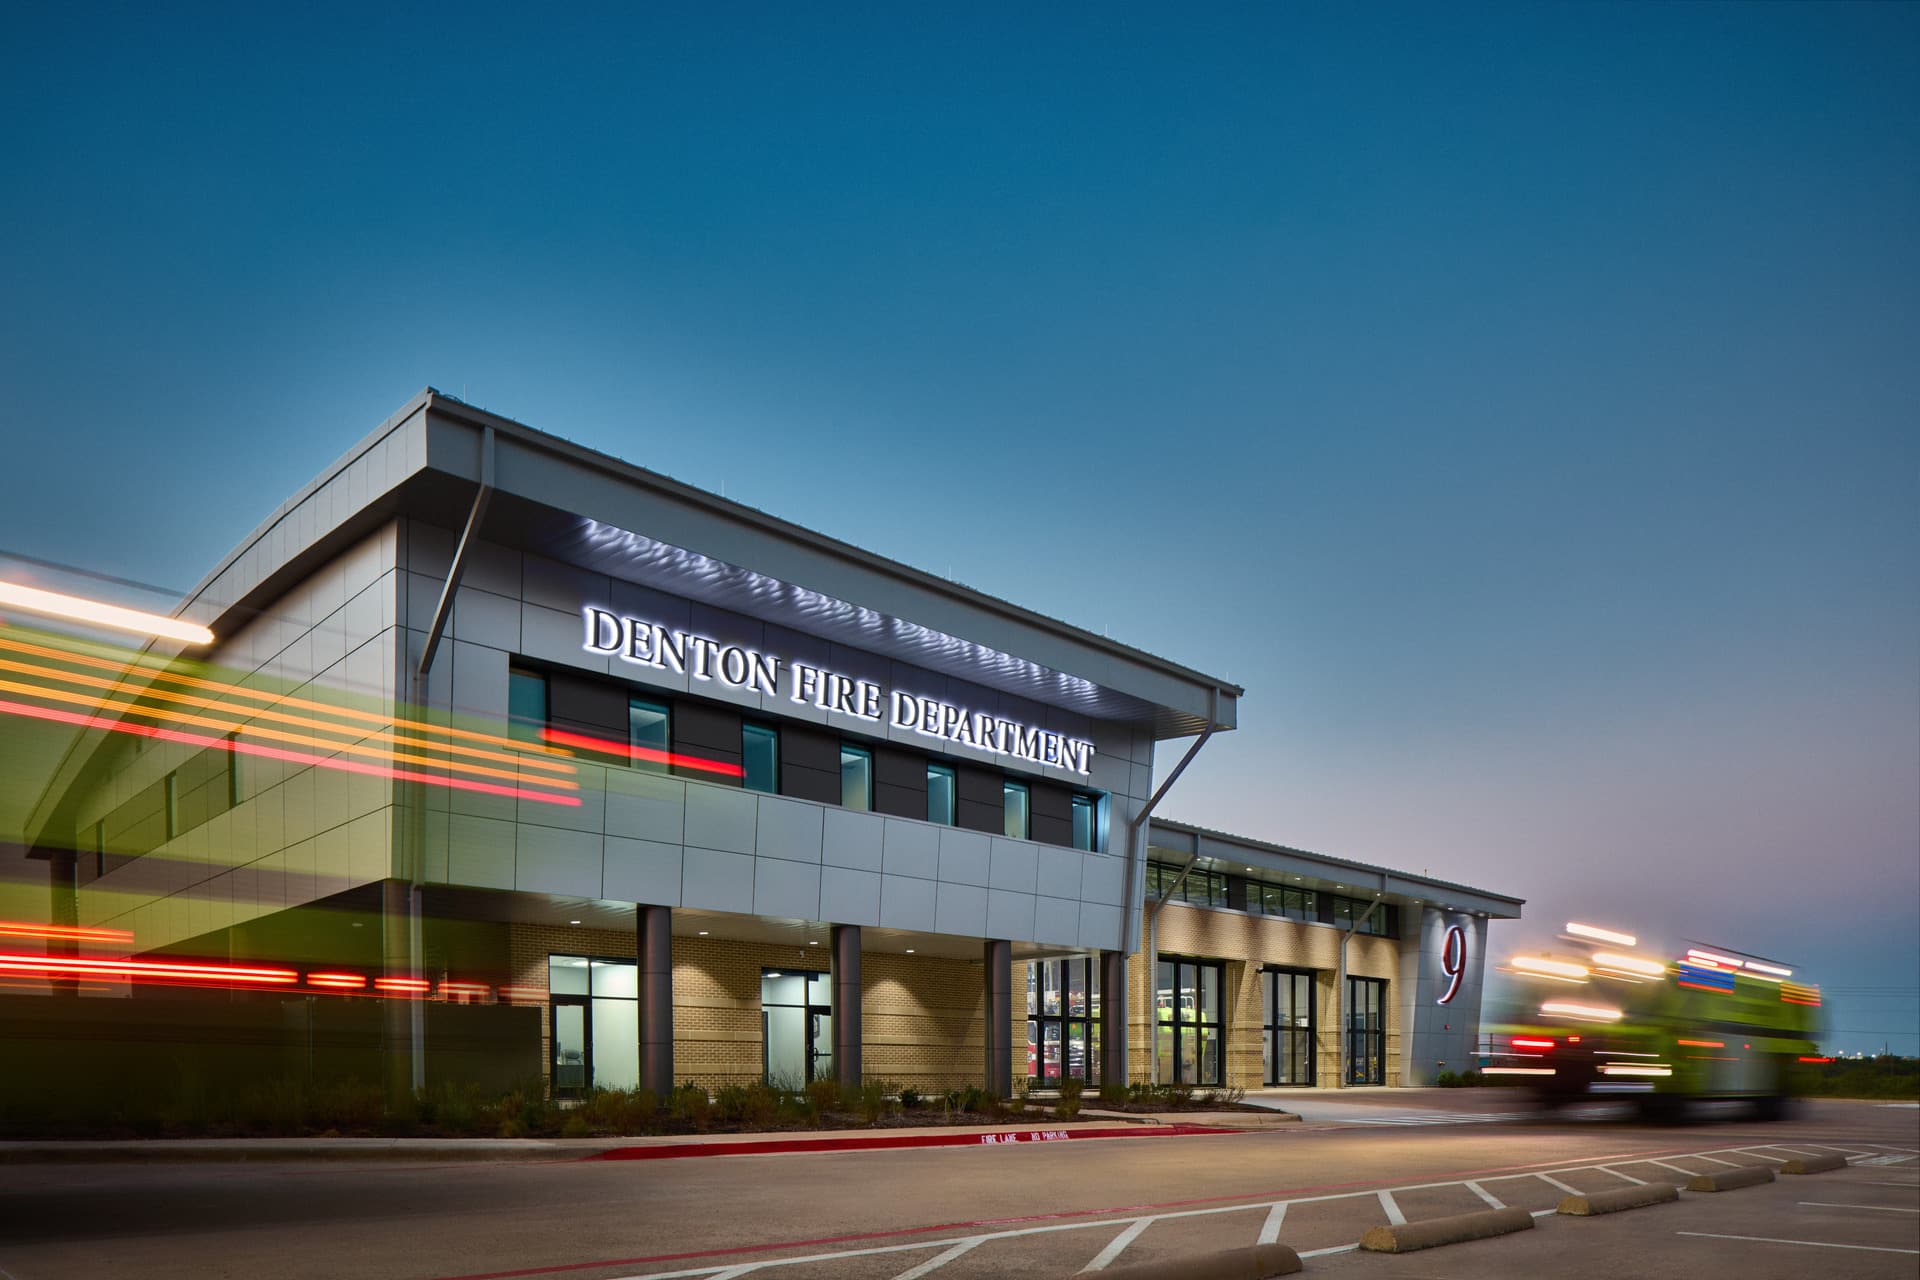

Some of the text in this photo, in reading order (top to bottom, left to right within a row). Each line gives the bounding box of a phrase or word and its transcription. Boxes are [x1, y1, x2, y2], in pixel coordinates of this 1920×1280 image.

[584, 607, 1096, 775] DENTON FIRE DEPARTMENT
[1437, 925, 1467, 1005] 9
[981, 1130, 1069, 1144] FIRE LANE NO PARKING
